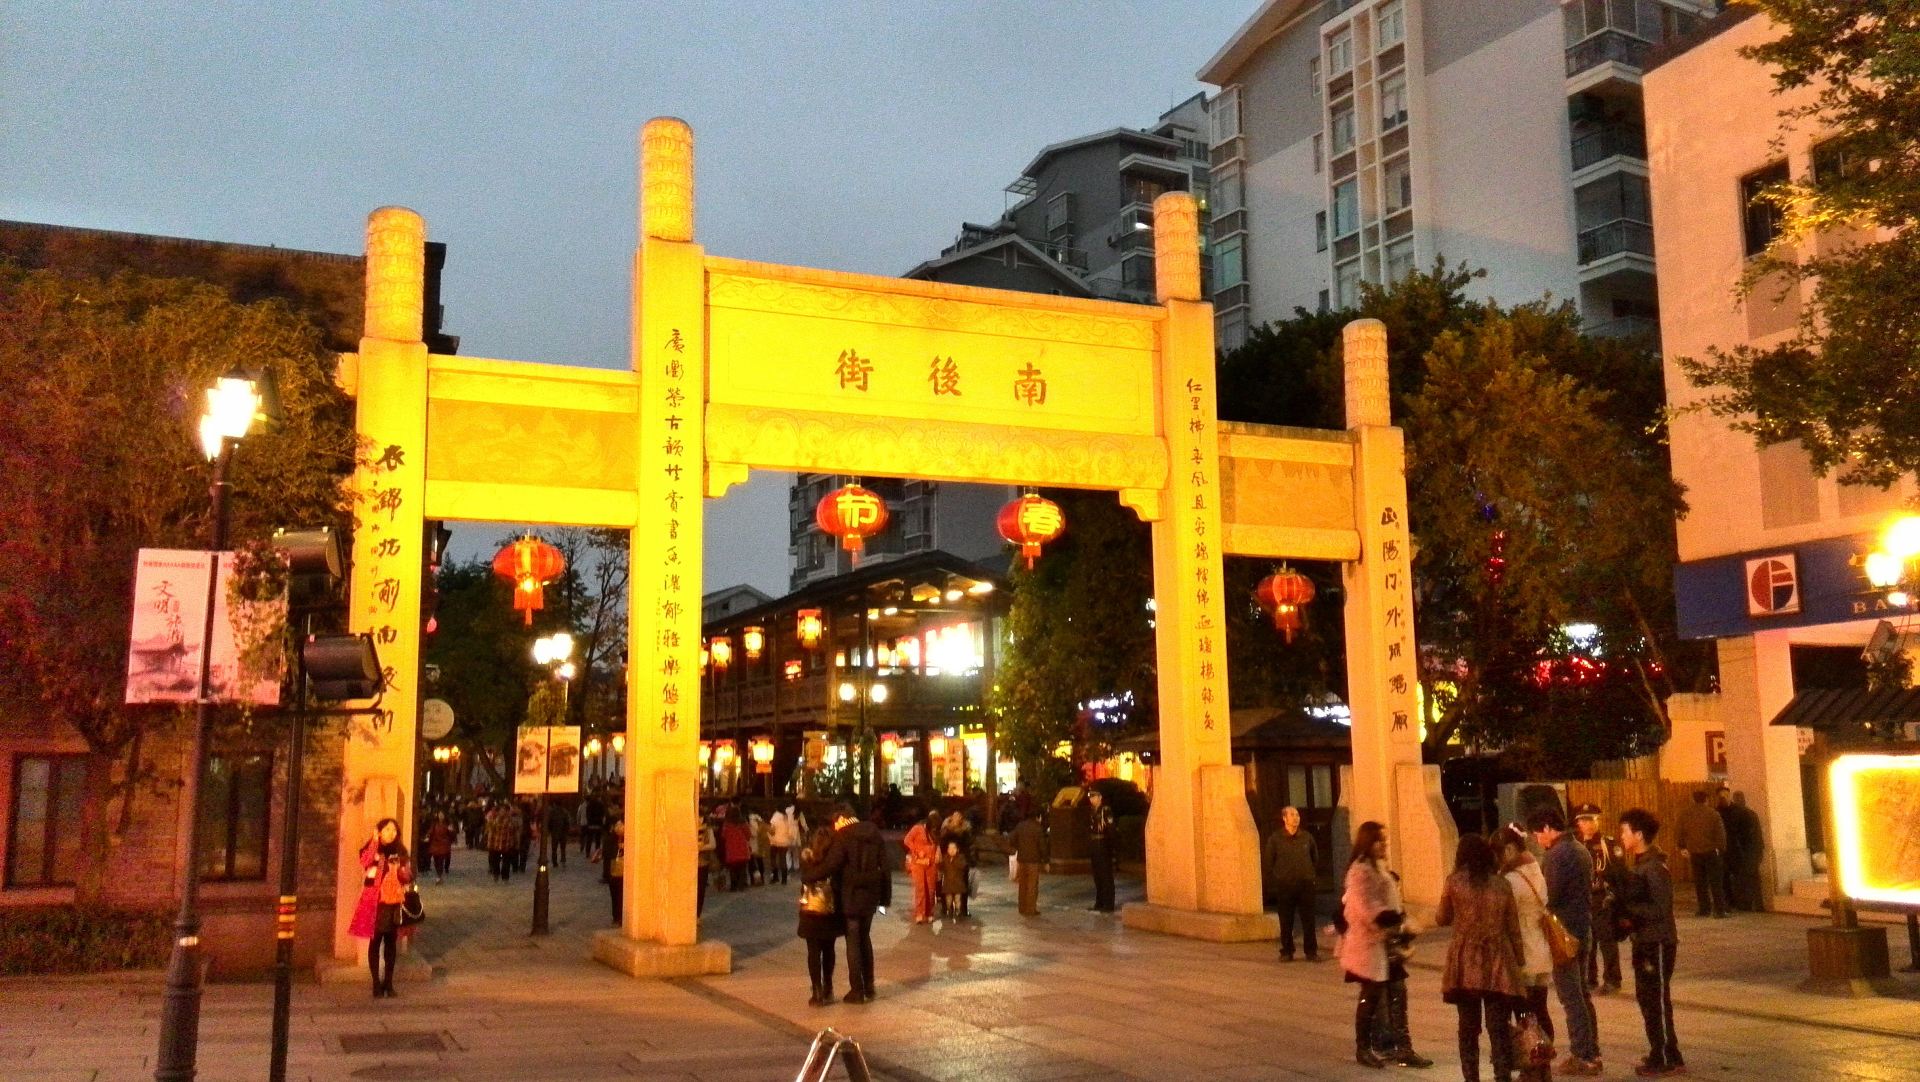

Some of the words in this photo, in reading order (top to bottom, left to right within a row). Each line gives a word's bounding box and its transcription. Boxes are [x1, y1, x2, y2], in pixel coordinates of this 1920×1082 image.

[834, 348, 1048, 406] 南後街
[1022, 501, 1062, 535] 春
